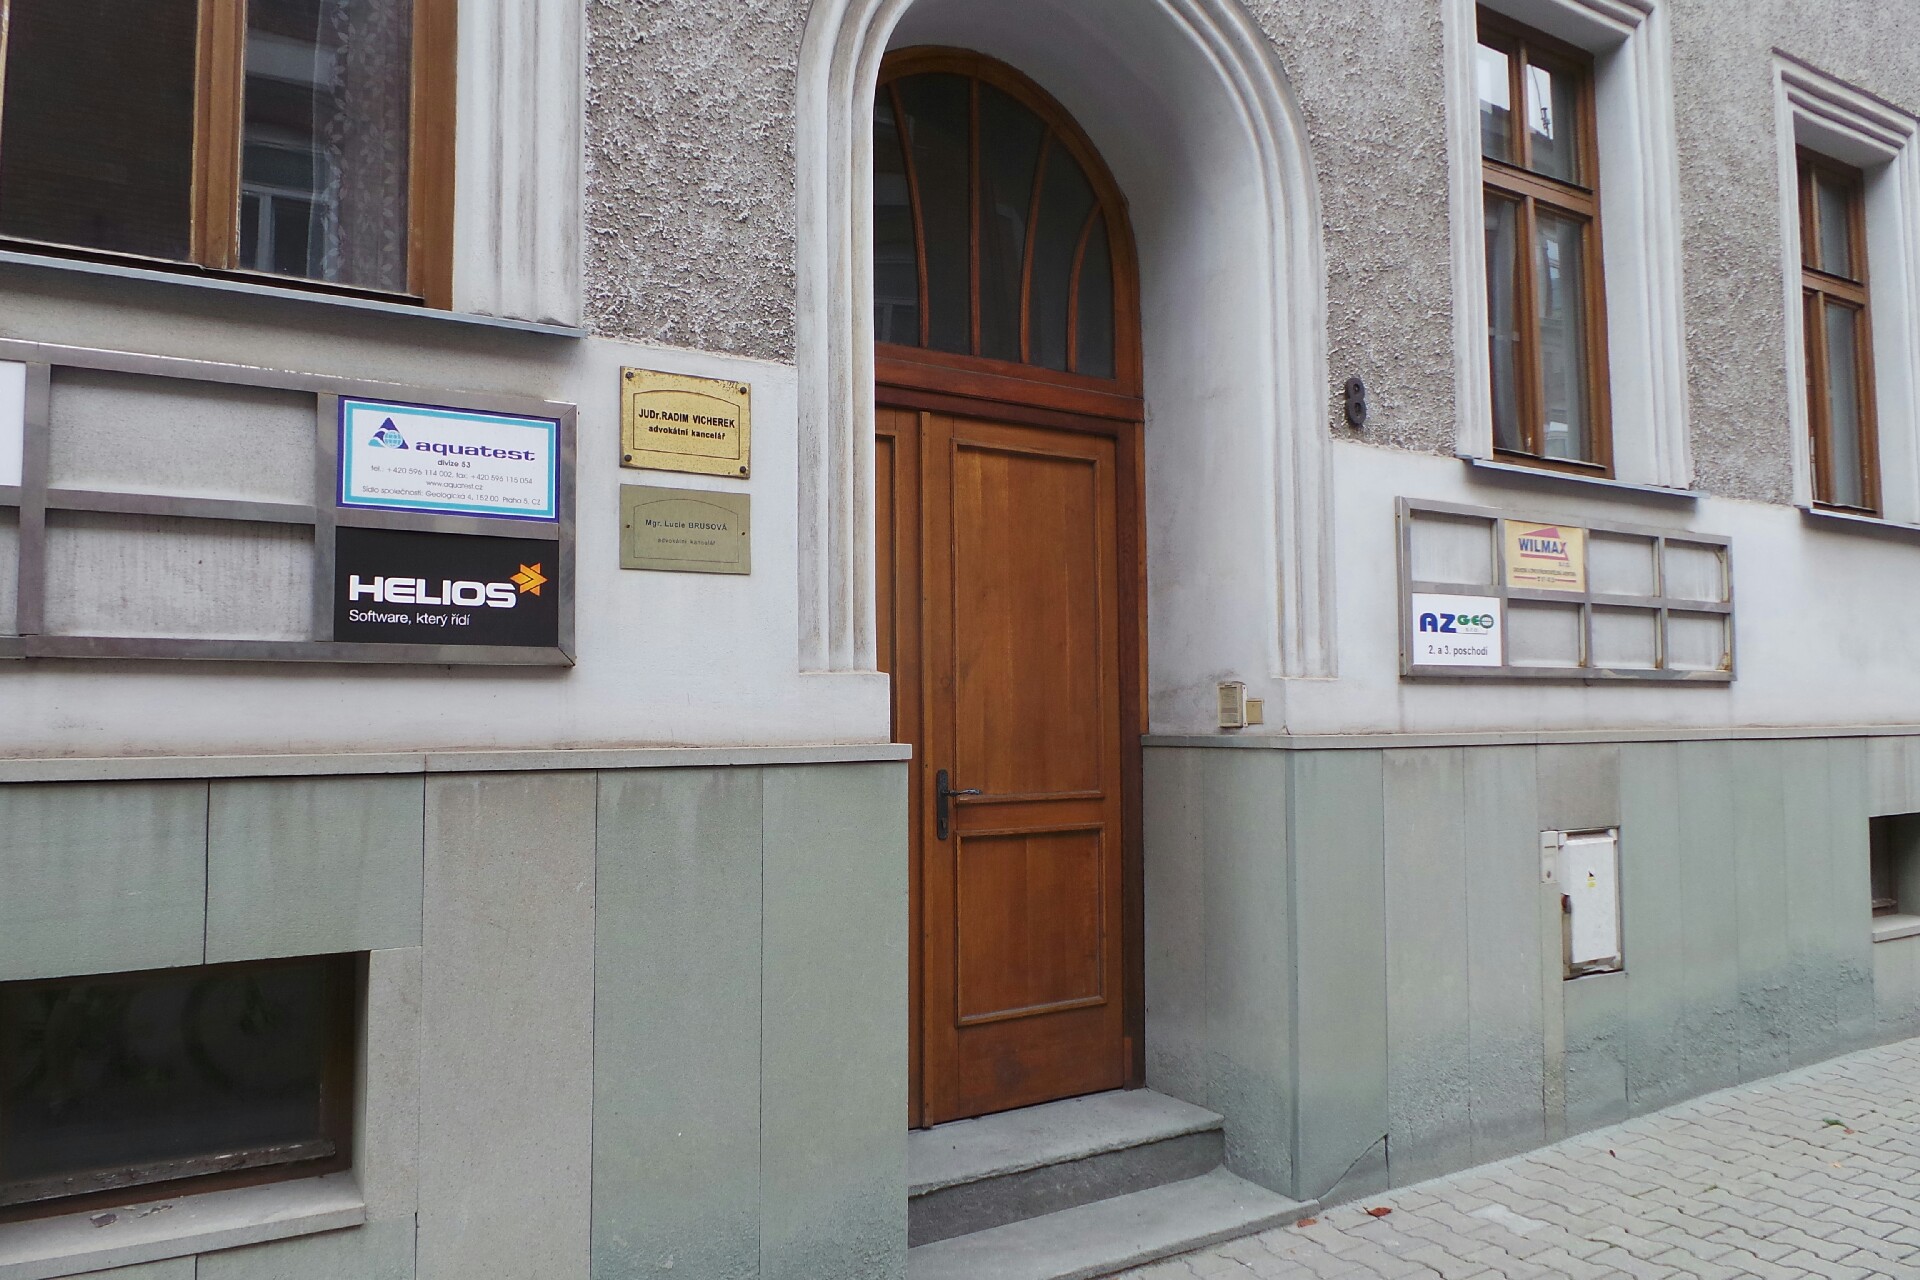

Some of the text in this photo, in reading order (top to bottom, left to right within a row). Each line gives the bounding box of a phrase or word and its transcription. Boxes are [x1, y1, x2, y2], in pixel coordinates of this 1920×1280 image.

[1345, 377, 1367, 430] 8
[692, 414, 736, 429] VICHEREK
[648, 425, 726, 440] advokátní kancelář
[415, 441, 536, 461] aquatest
[437, 459, 459, 468] divize
[387, 467, 407, 475] +420
[408, 467, 423, 476] 596
[425, 469, 438, 477] 114
[471, 473, 490, 481] +420
[426, 480, 484, 491] www.aquatest.cz
[362, 485, 380, 494] Sídlo
[502, 496, 522, 504] Praha
[531, 498, 541, 506] CZ
[645, 519, 728, 531] Mgr. Lucie BRUSOVÁ
[1518, 537, 1567, 555] WILMAX
[349, 574, 517, 609] HELIOS
[349, 609, 471, 628] Software, který řídí
[1428, 644, 1488, 658] 2. a 3. poschodí
